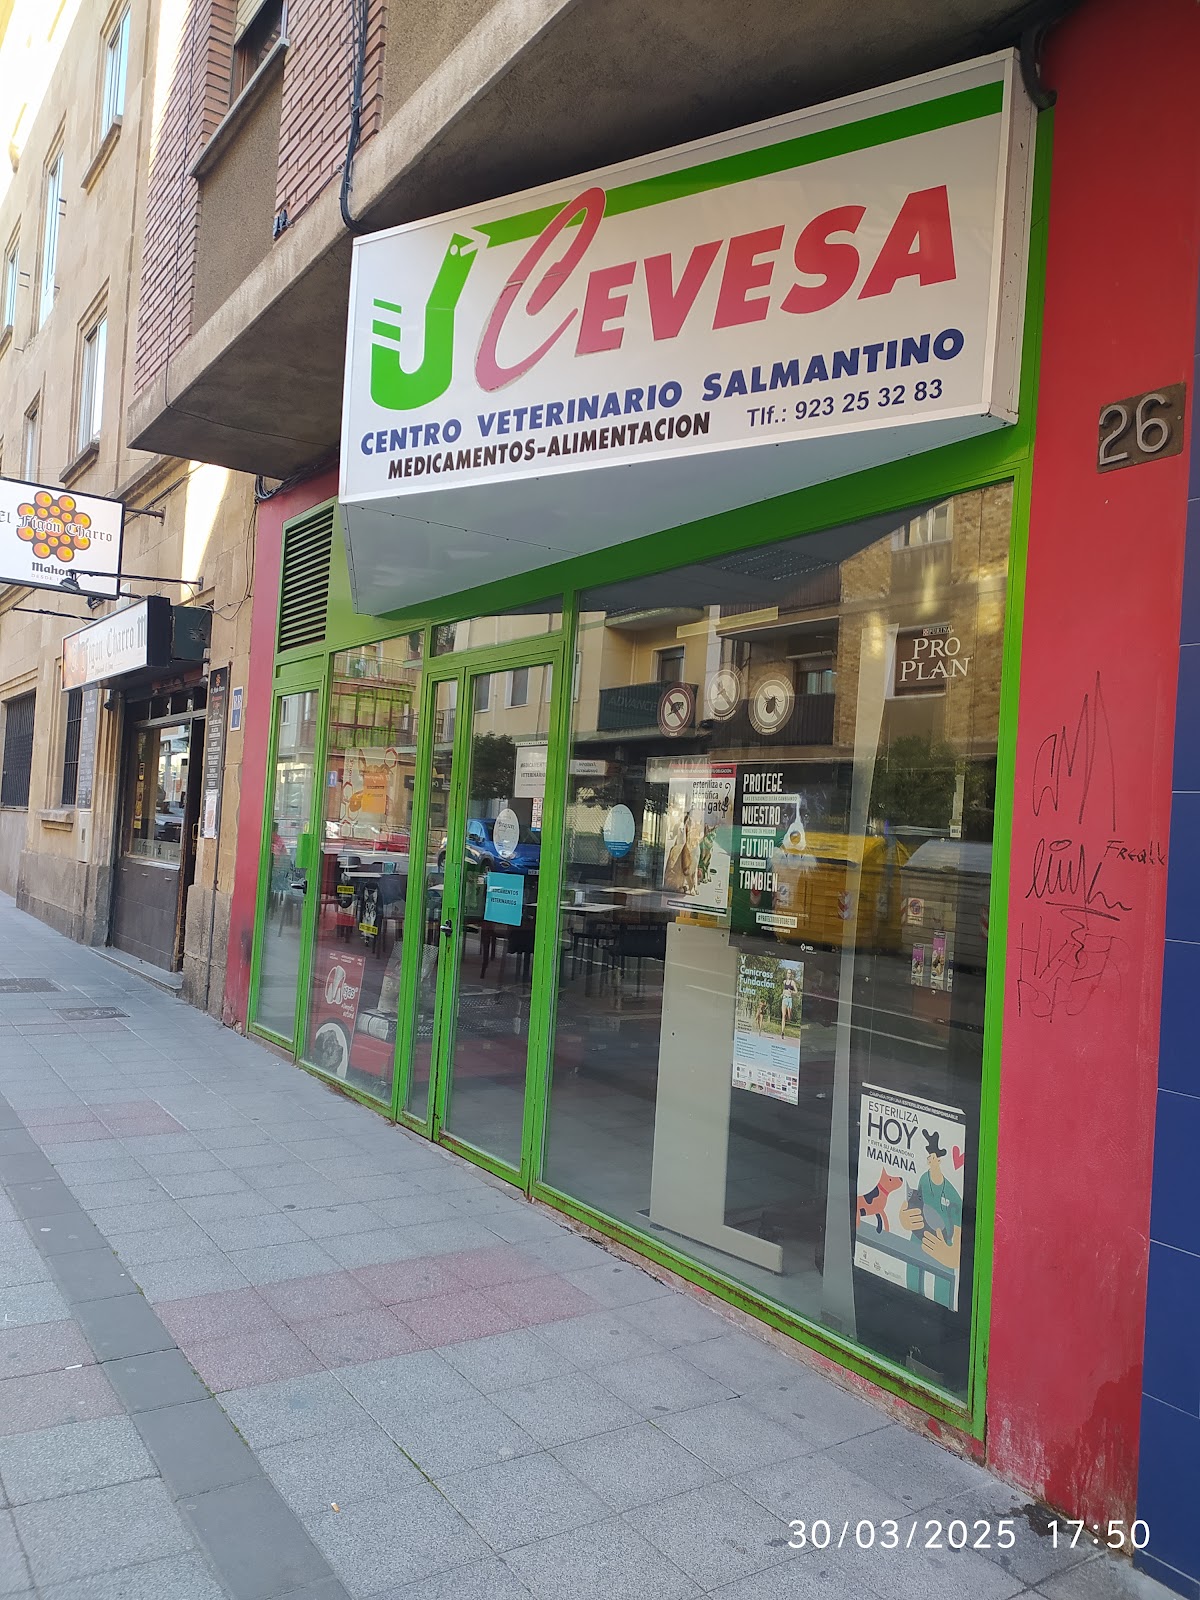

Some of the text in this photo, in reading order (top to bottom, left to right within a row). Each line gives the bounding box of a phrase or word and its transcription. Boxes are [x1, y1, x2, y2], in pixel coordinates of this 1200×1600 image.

[475, 184, 957, 393] CEVESA
[361, 328, 965, 456] CENTRO VETERINARIO SALMANTINO
[747, 378, 943, 427] Tlf.: 923 25 32 83
[1099, 393, 1169, 465] 26
[388, 411, 711, 480] MEDICAMENTOS-ALIMENTACION
[64, 522, 113, 542] Charro
[911, 636, 961, 660] PRO
[899, 657, 971, 682] PLAN
[693, 780, 718, 788] esteriliza
[743, 773, 784, 793] PROTEGE
[742, 805, 781, 826] NUESTRO
[740, 837, 774, 859] FUTURO
[739, 974, 775, 989] Fundación
[740, 965, 774, 979] Canicross
[869, 1101, 919, 1124] ESTERILIZA
[867, 1112, 918, 1149] HOY
[867, 1146, 917, 1174] MAÑANA
